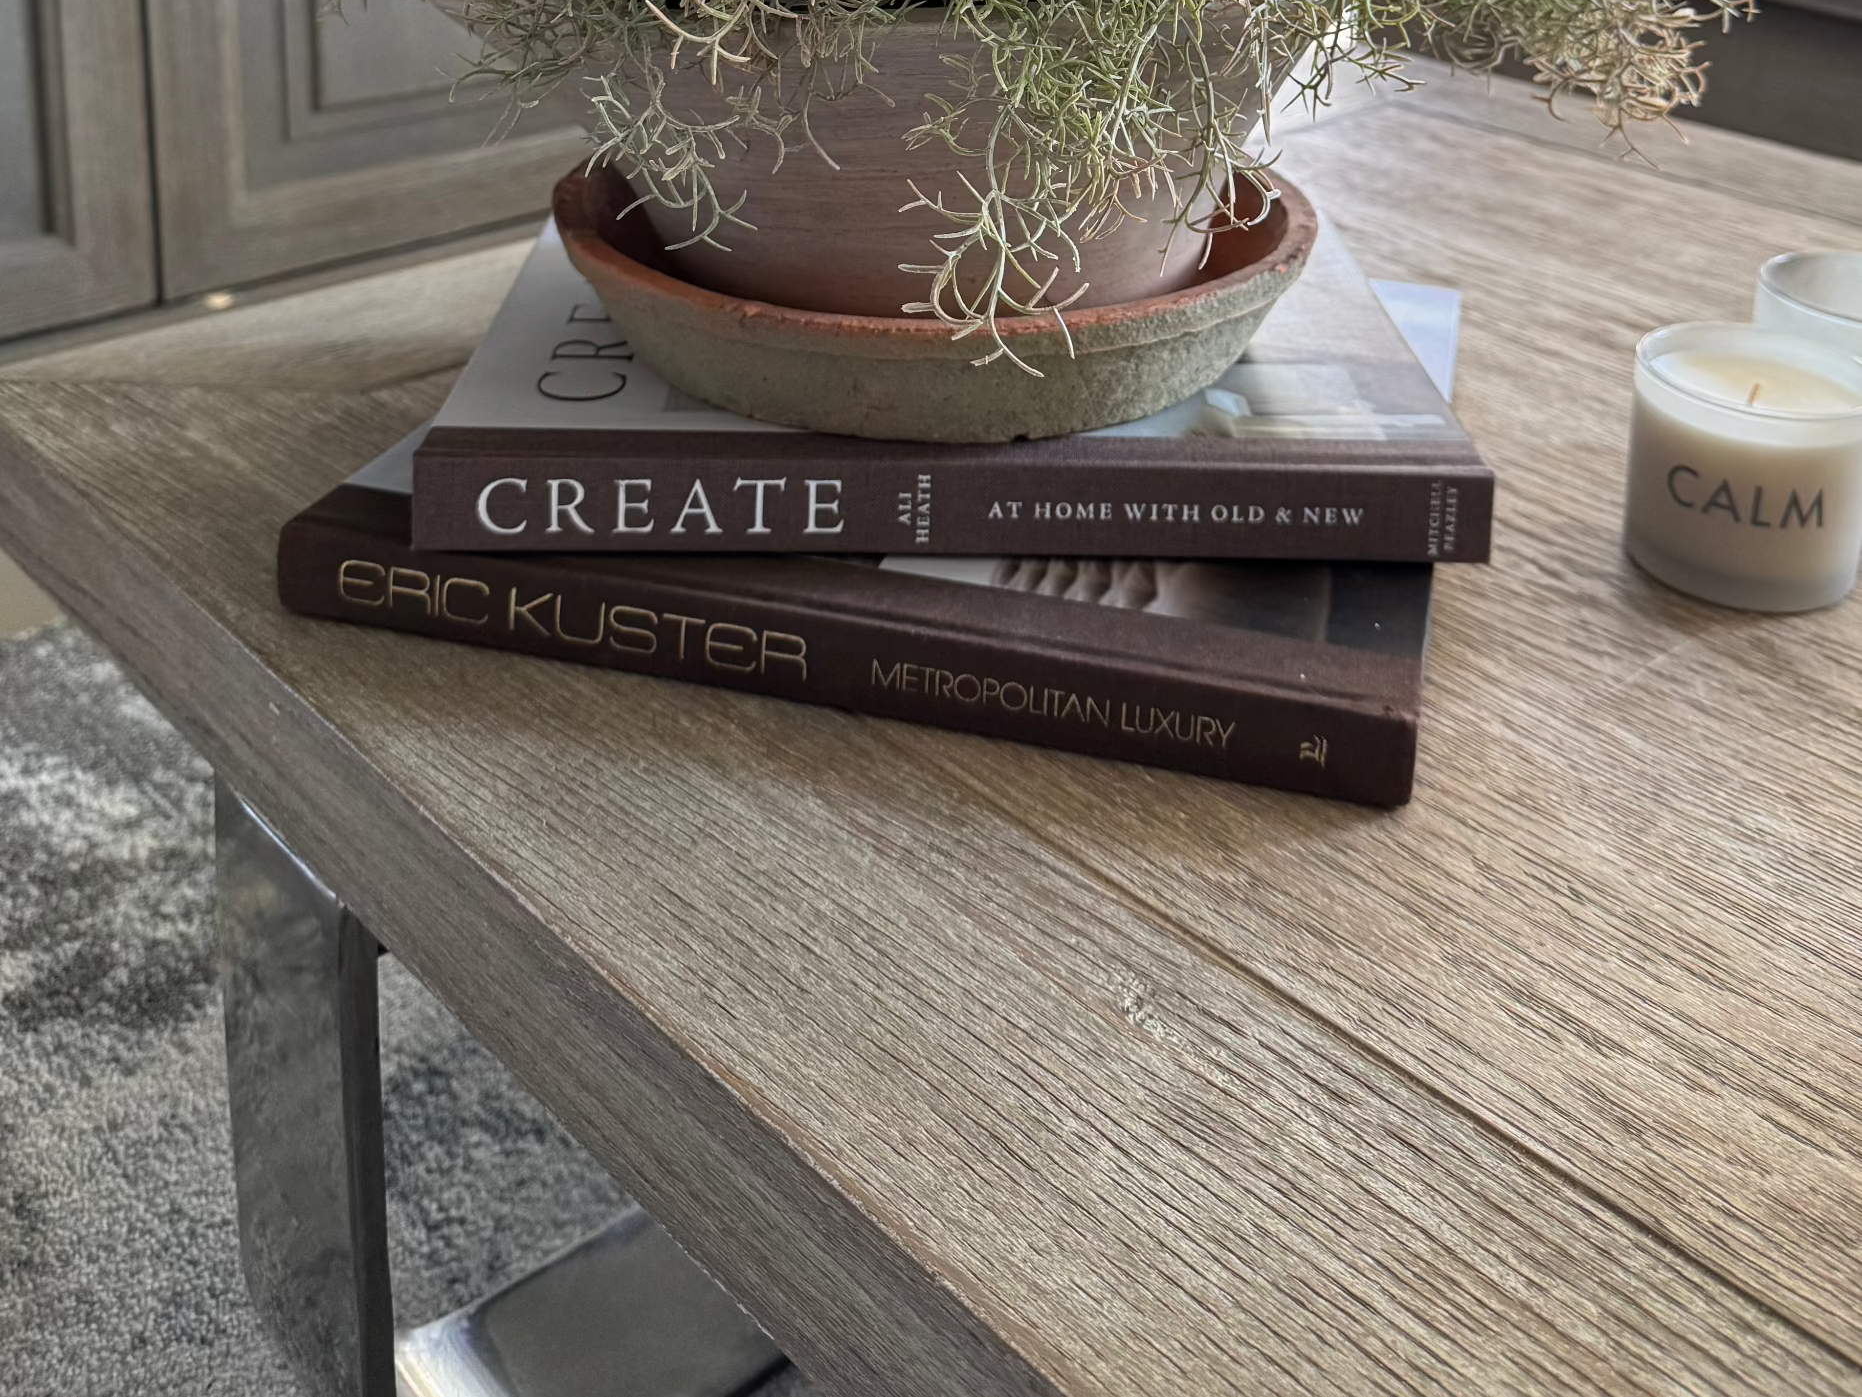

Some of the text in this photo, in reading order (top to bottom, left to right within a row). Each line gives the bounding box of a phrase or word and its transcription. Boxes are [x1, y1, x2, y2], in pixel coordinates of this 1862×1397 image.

[477, 477, 845, 535] CREATE
[898, 492, 912, 526] ALI
[915, 474, 932, 544] HEATH
[988, 501, 1364, 526] AT HOME WITH OLD & NEW
[1666, 464, 1825, 528] CALM
[337, 558, 808, 682] ERIC KUSTER
[870, 657, 1237, 749] METROPOLITAN LUXURY
